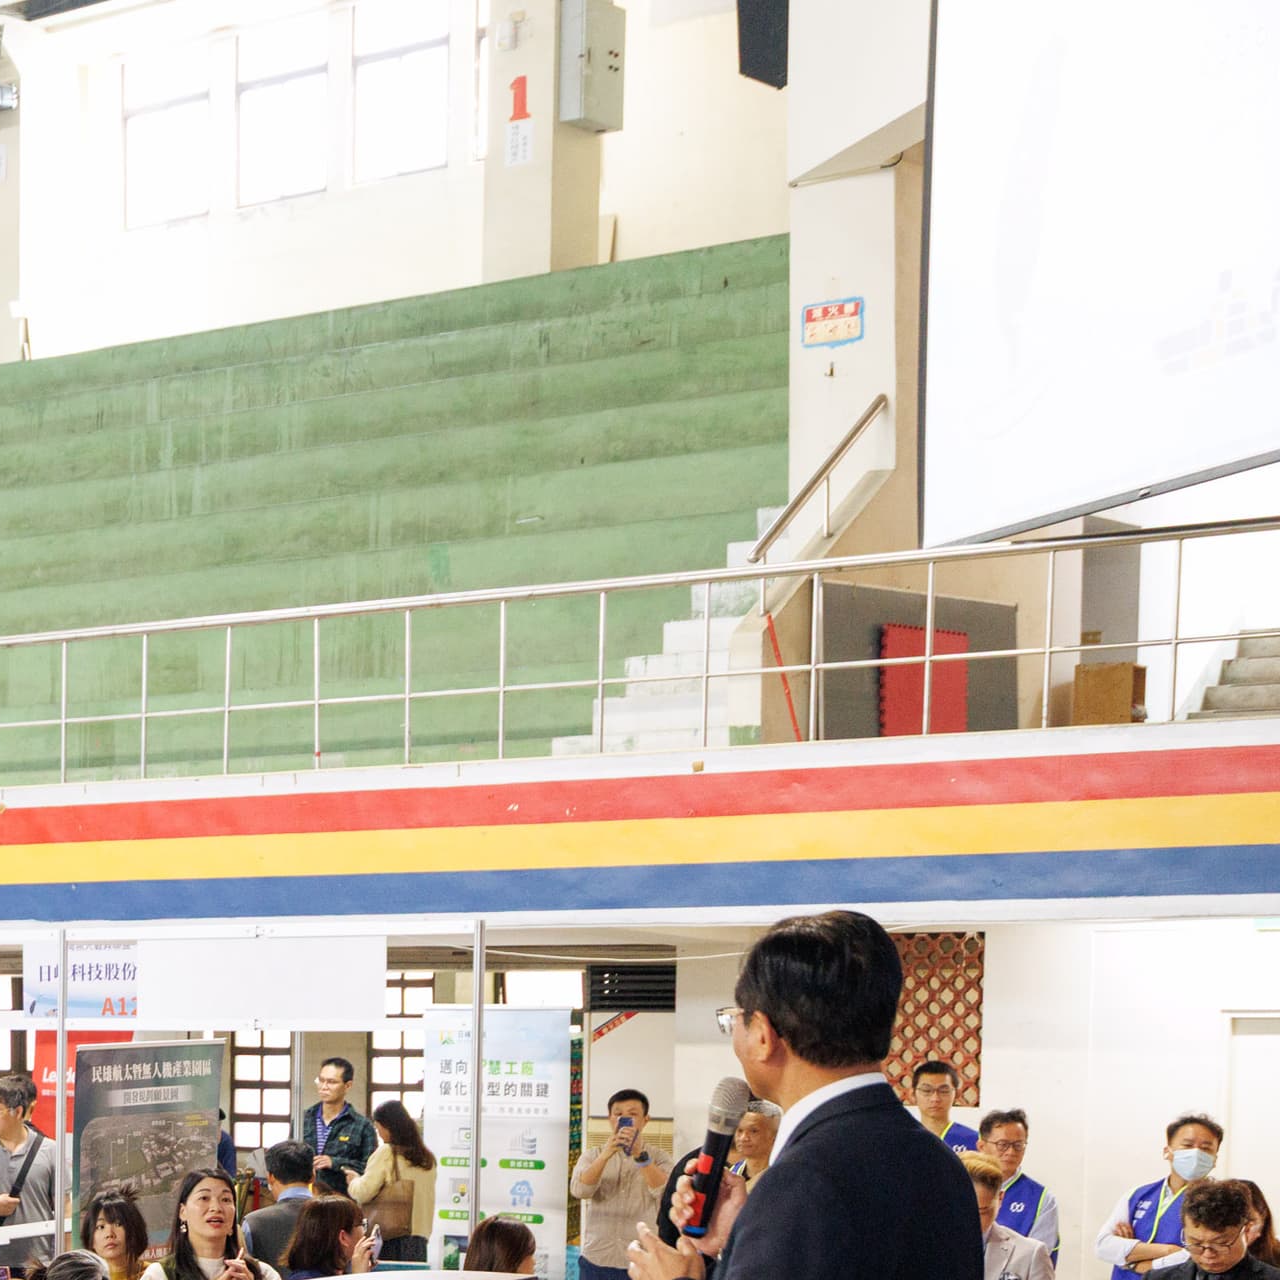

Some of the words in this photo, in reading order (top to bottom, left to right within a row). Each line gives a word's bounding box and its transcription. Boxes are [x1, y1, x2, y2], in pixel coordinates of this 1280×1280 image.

[510, 75, 531, 121] 1
[440, 1058, 535, 1076] 邁向慧工廠
[440, 1081, 550, 1098] 優化型的關鍵
